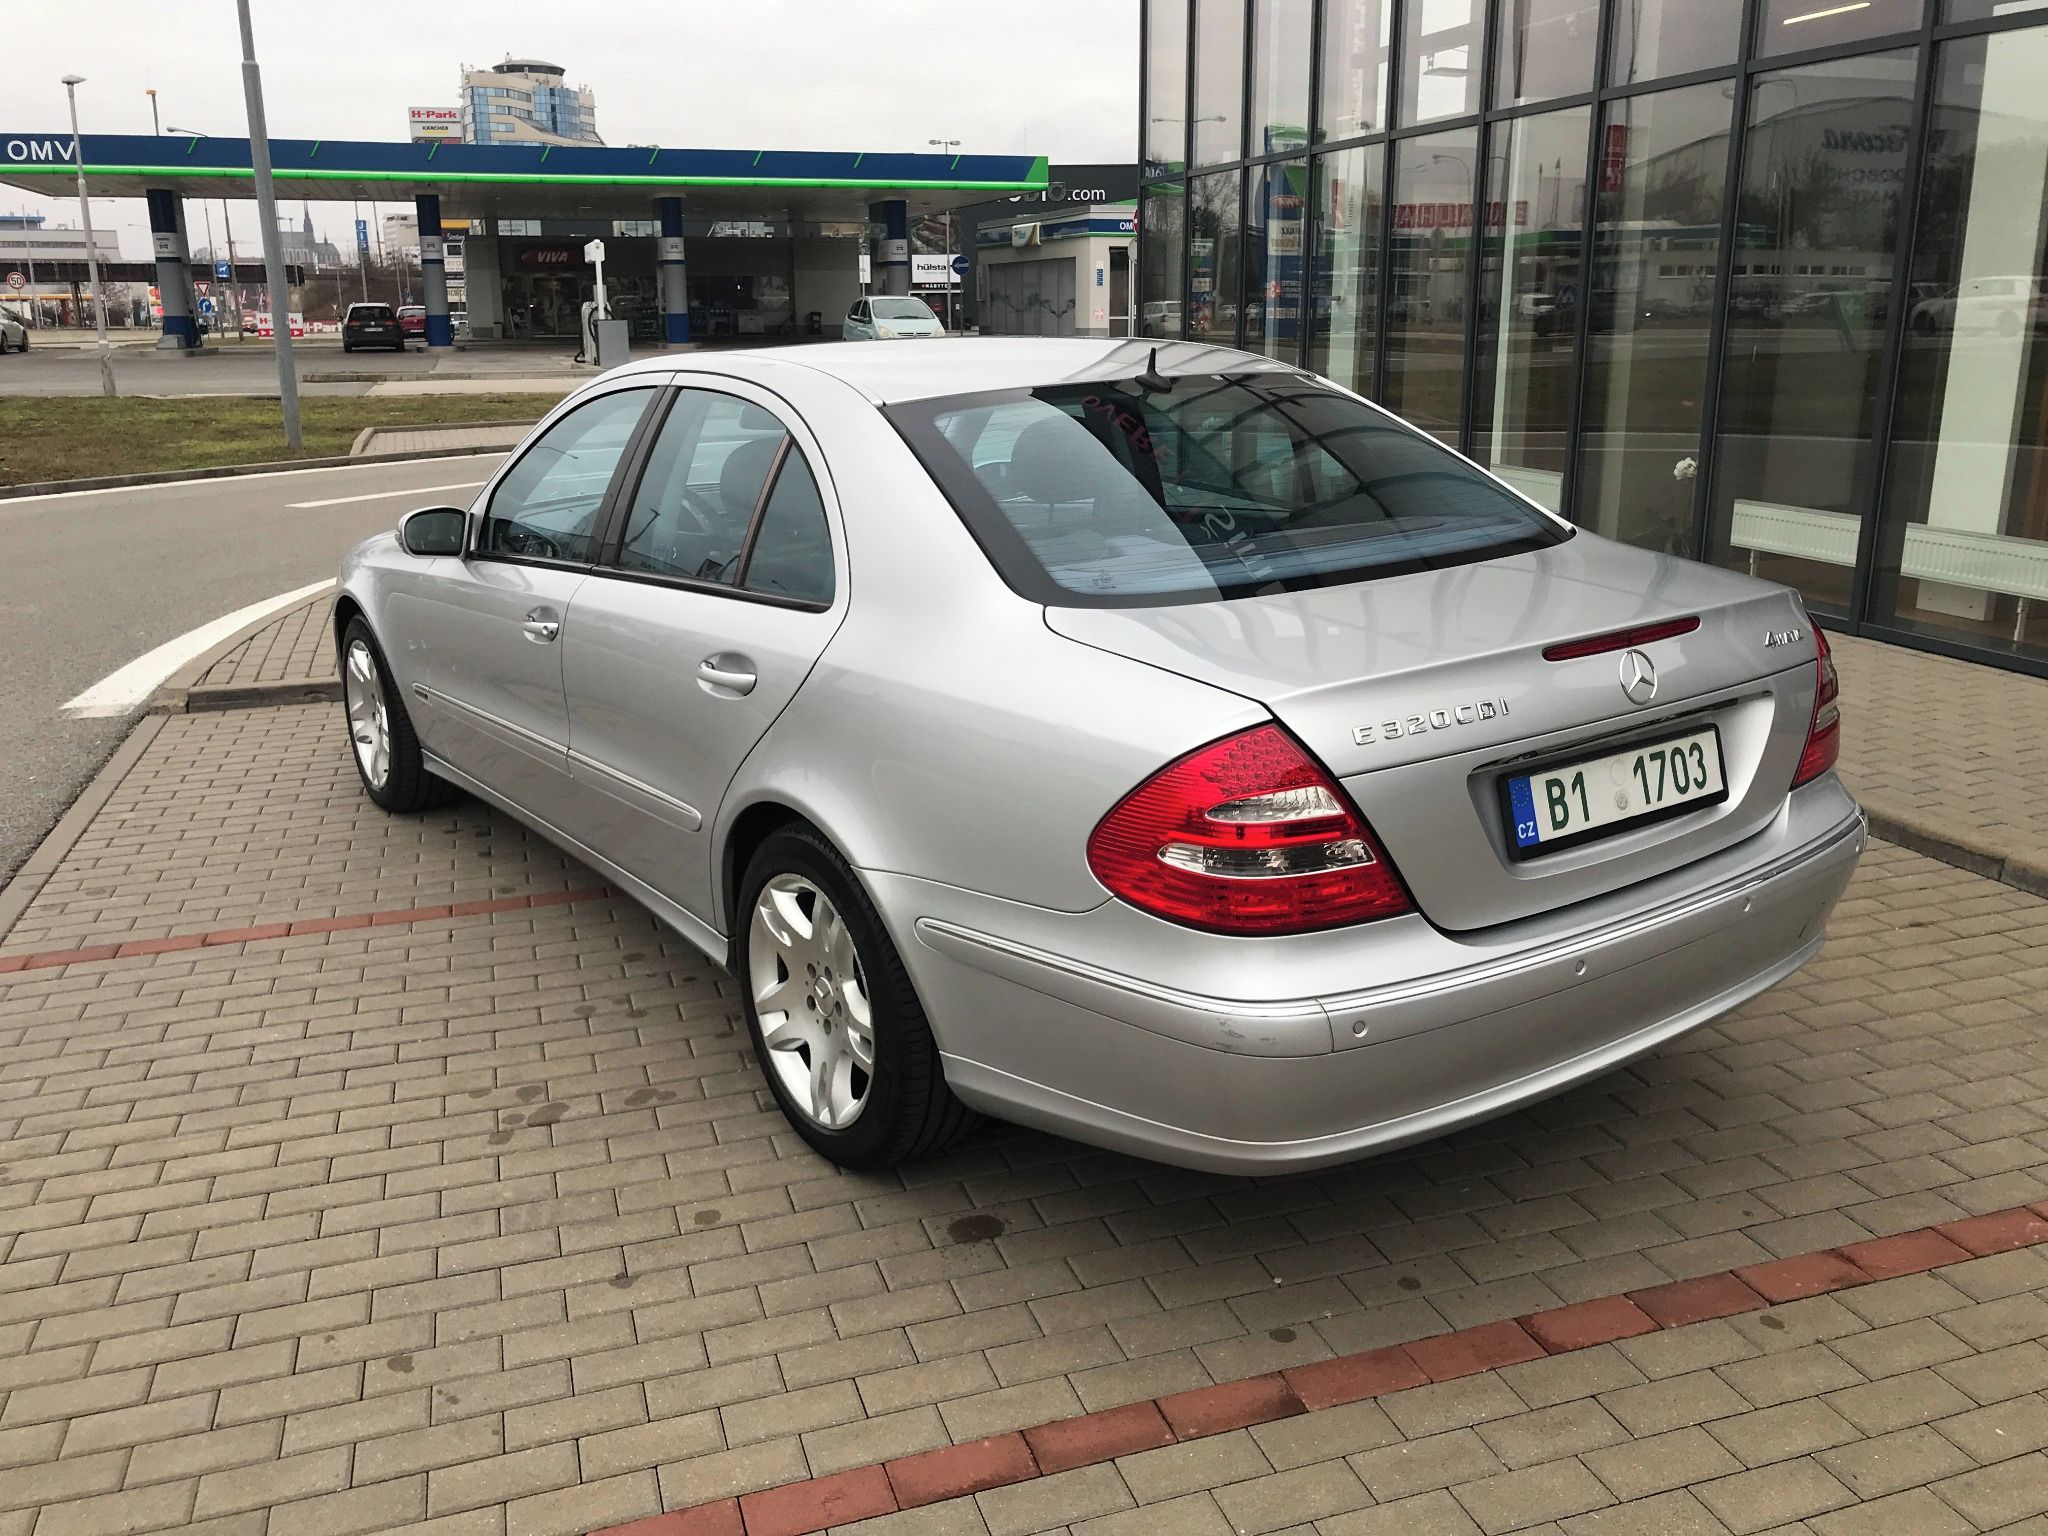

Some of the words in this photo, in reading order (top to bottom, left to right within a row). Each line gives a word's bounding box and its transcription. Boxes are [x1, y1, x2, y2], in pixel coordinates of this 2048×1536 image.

[411, 110, 457, 119] H-Park
[7, 139, 75, 161] OMV
[1119, 221, 1134, 231] OM
[537, 250, 568, 263] VIVA
[916, 263, 947, 271] hülsta
[10, 276, 22, 286] 50
[1545, 771, 1590, 831] B1
[1632, 742, 1708, 805] 1703
[1517, 821, 1536, 839] CZ
